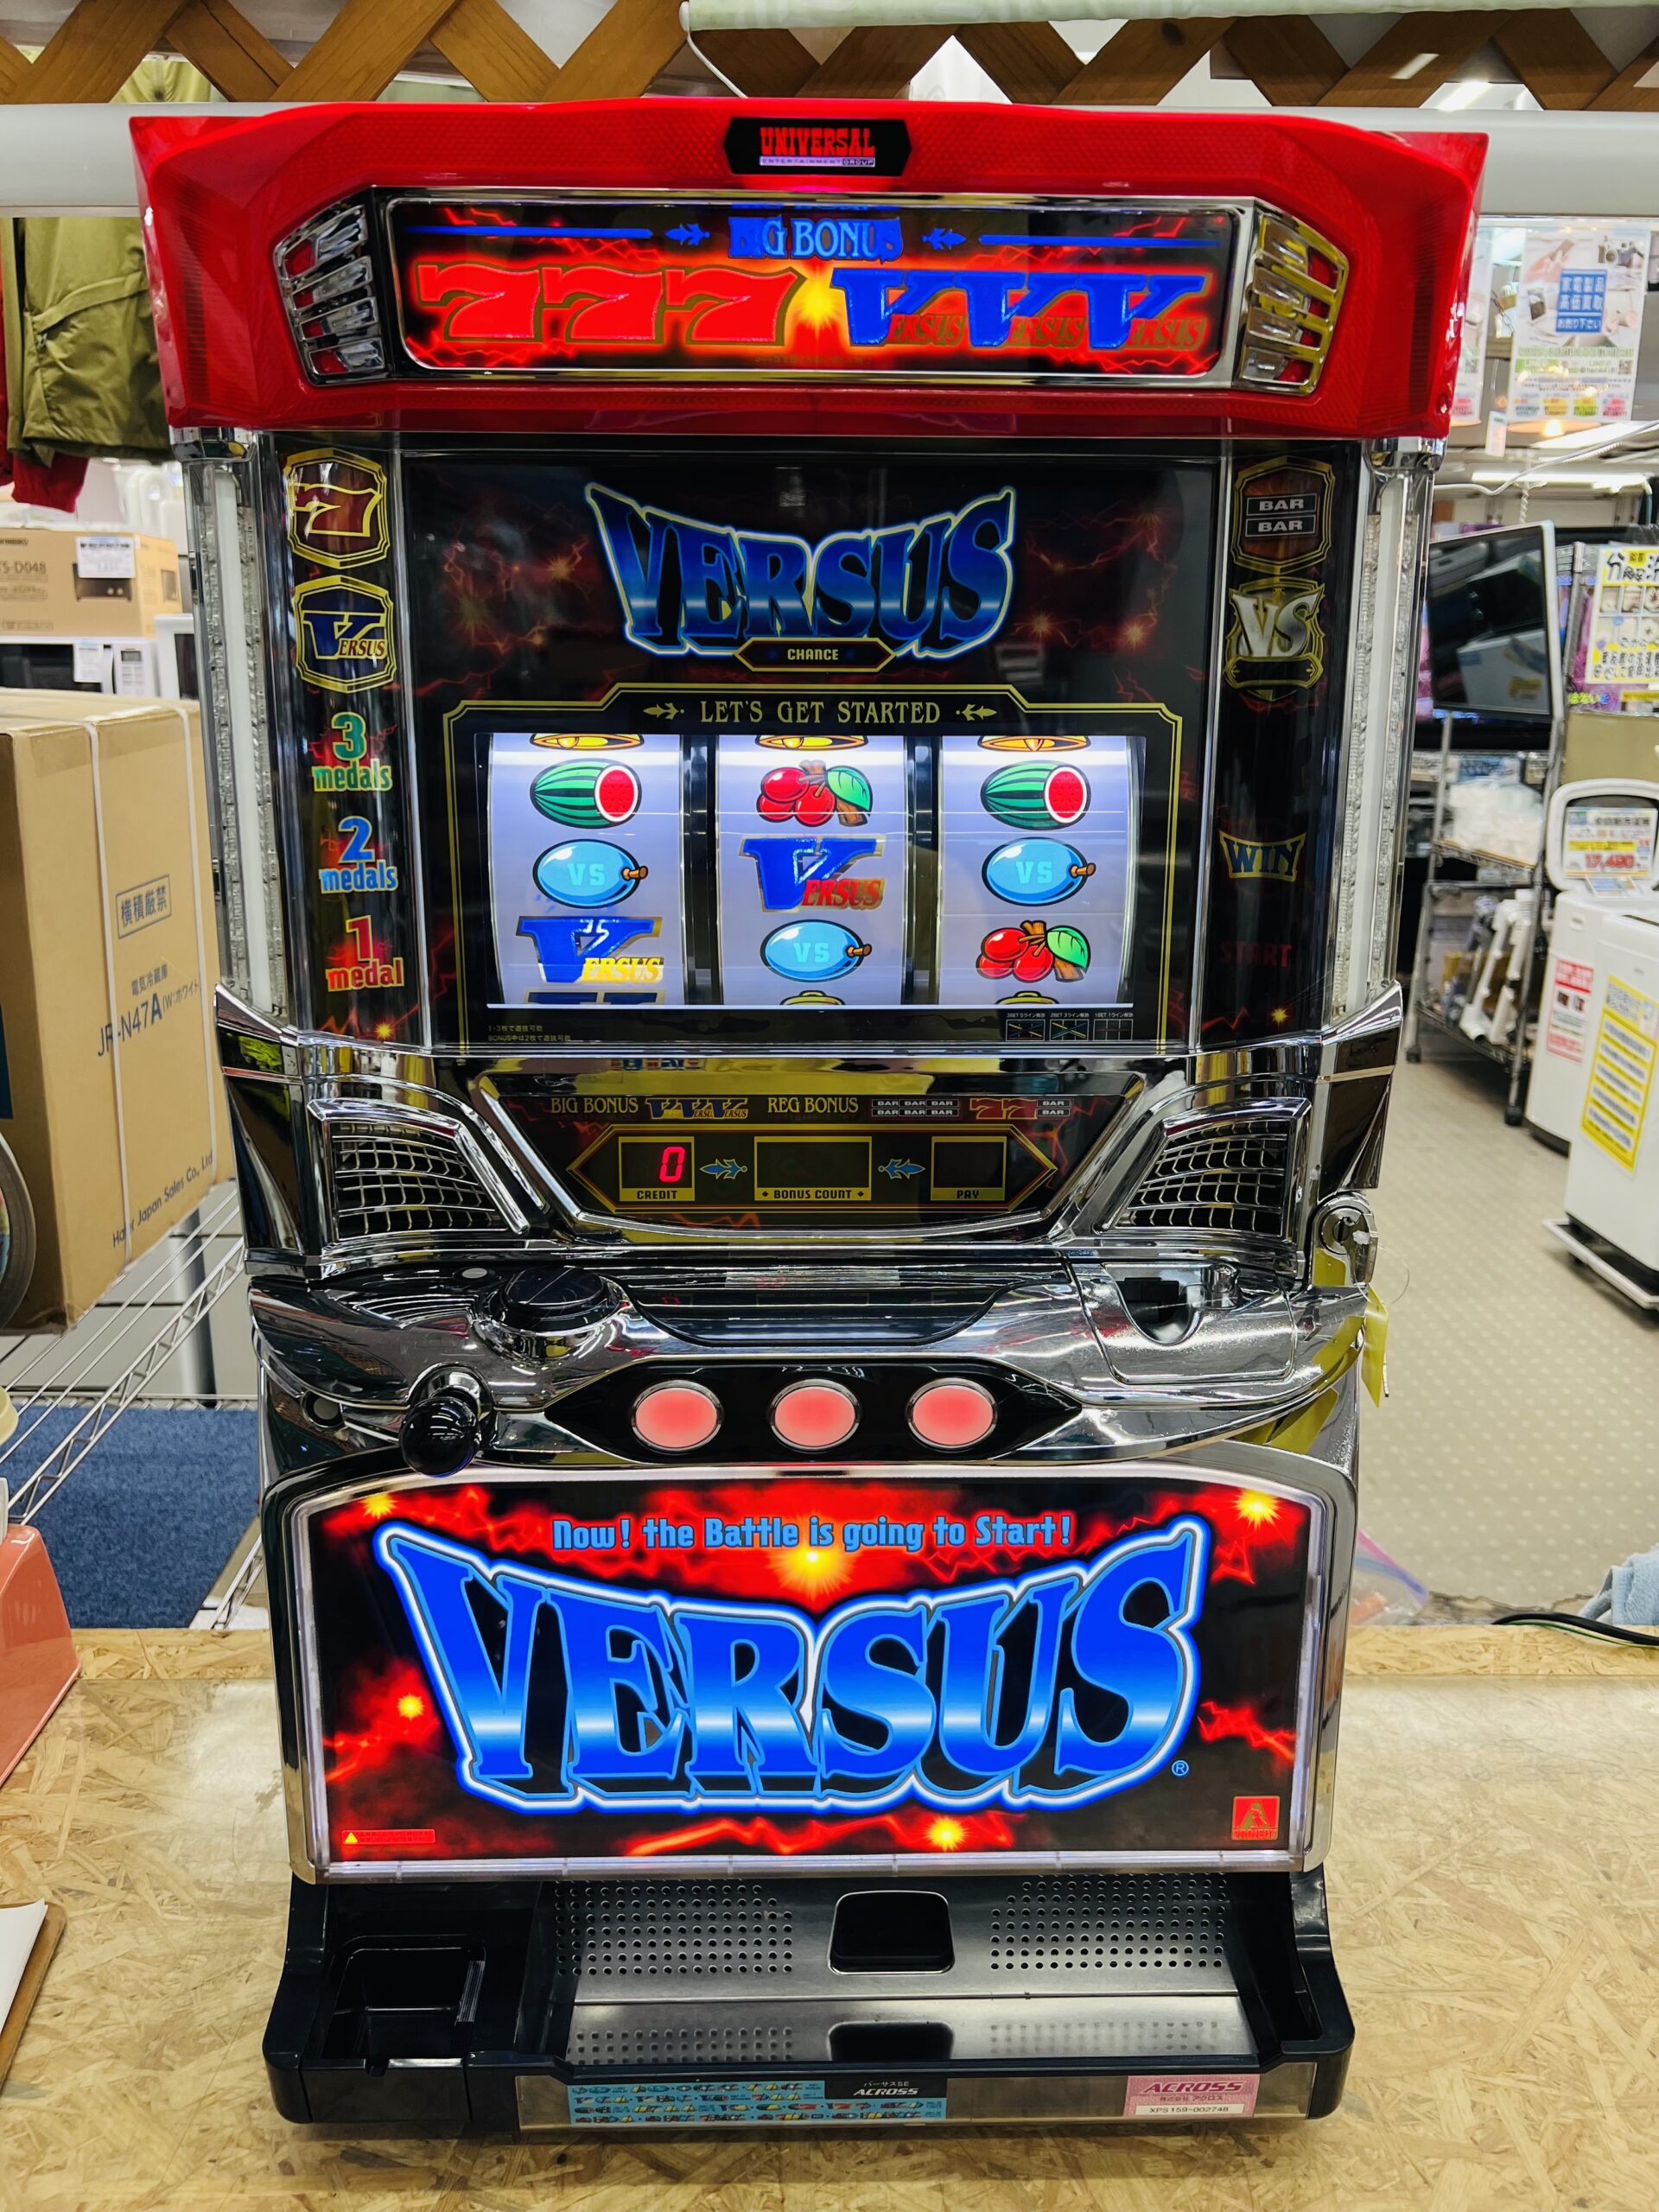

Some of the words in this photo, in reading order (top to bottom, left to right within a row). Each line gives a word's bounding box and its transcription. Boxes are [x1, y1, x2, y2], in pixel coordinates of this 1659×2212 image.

[760, 127, 875, 156] UNIVERSAL
[1259, 499, 1304, 512] BAR
[1258, 520, 1303, 533] BAR
[585, 481, 1016, 658] VERSUS
[1230, 584, 1325, 658] VS
[787, 648, 839, 661] CHANCE
[700, 701, 763, 723] LET'S
[777, 701, 824, 723] GET
[837, 701, 940, 724] STARTED
[331, 712, 367, 760] 3
[312, 759, 392, 791] medals
[338, 816, 375, 863] 2
[1015, 861, 1053, 884] VS
[1221, 833, 1304, 880] WIN
[319, 859, 398, 893] medals
[567, 863, 605, 887] VS
[121, 884, 168, 929] 横積厳禁
[346, 914, 372, 962] 1
[794, 942, 830, 963] VS
[131, 963, 168, 995] 電気冷蔵庫
[326, 957, 404, 991] medal
[550, 1097, 578, 1113] BIG
[583, 1097, 639, 1113] BONUS
[768, 1097, 801, 1114] REG
[804, 1096, 859, 1113] BONUS
[659, 1147, 685, 1182] 0
[637, 1190, 677, 1199] CREDIT
[773, 1190, 810, 1199] BONUS
[815, 1190, 852, 1199] COUNT
[957, 1190, 980, 1199] PAY
[112, 1218, 134, 1248] Har
[137, 1197, 162, 1226] Japan
[163, 1178, 184, 1202] Sales
[552, 1518, 630, 1549] Now!
[641, 1518, 694, 1548] the
[704, 1517, 798, 1548] Battle
[809, 1516, 833, 1547] is
[842, 1516, 924, 1551] going
[933, 1516, 965, 1546] to
[974, 1516, 1071, 1544] Start!
[373, 1521, 1208, 1814] VERSUS
[1142, 2082, 1244, 2093] ACROSS
